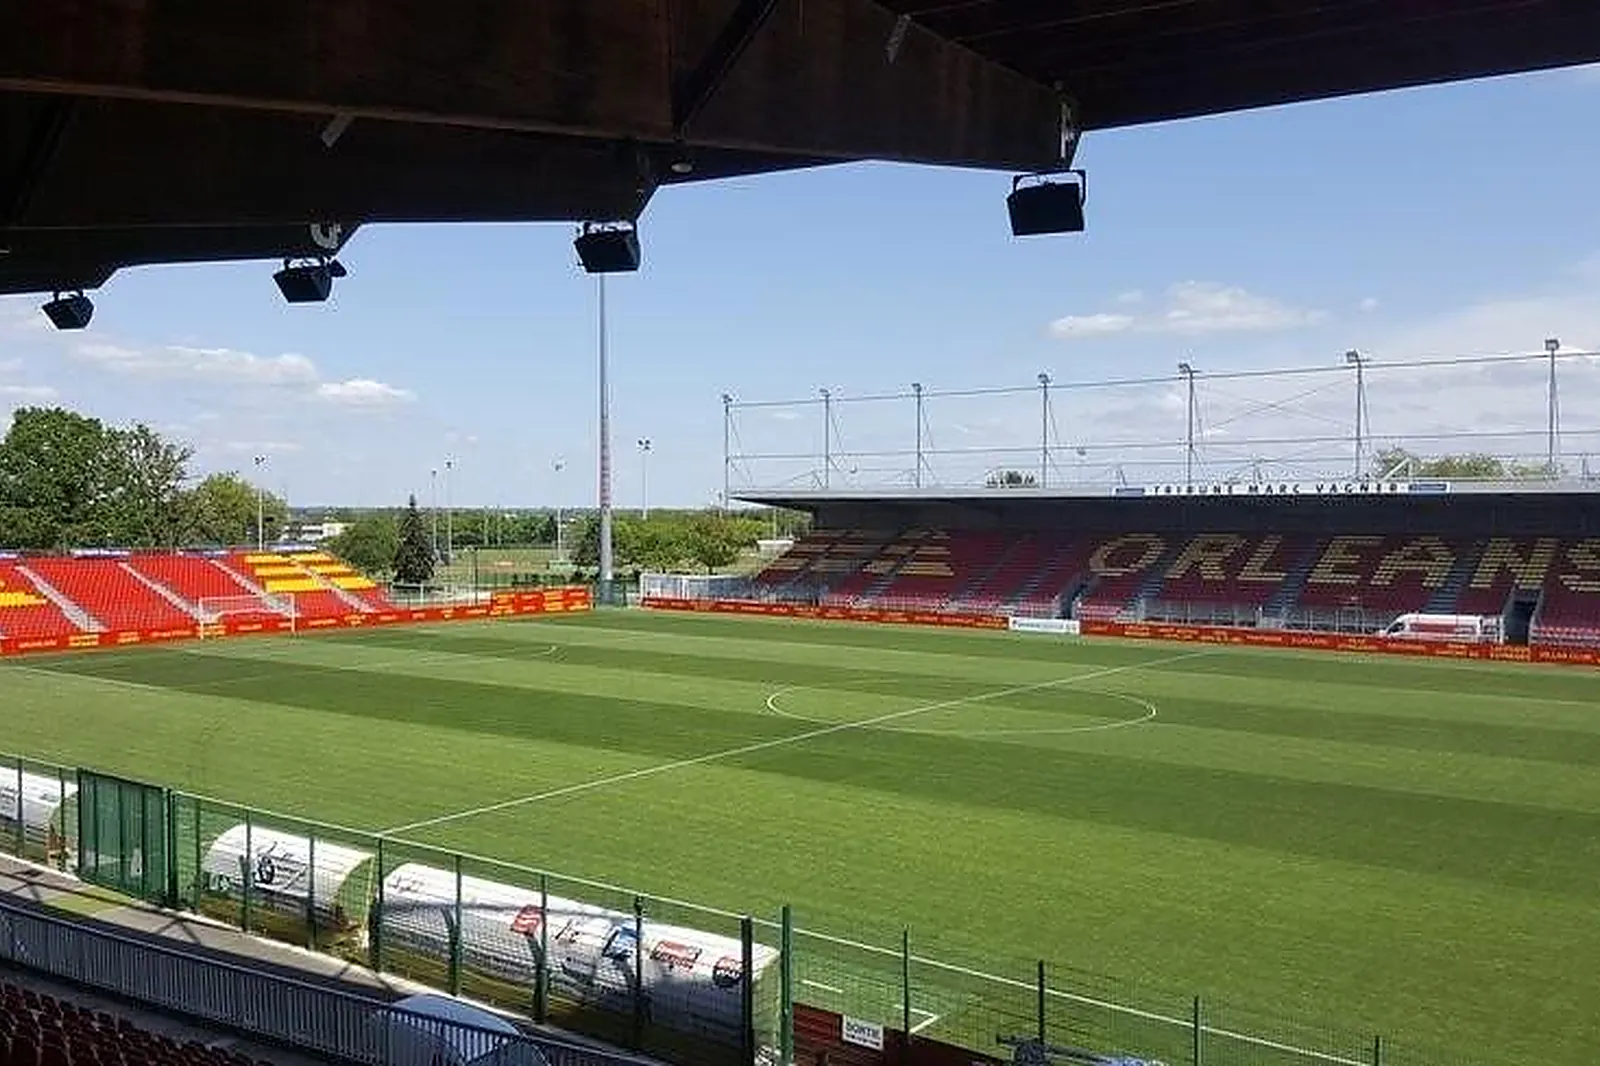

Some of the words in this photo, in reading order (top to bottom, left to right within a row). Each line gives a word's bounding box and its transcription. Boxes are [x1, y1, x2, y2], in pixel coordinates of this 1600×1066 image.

[1153, 485, 1233, 495] TRIBUNE
[1246, 484, 1300, 494] MARC
[1315, 483, 1398, 494] VAGNER
[1088, 532, 1600, 592] ORLEANS
